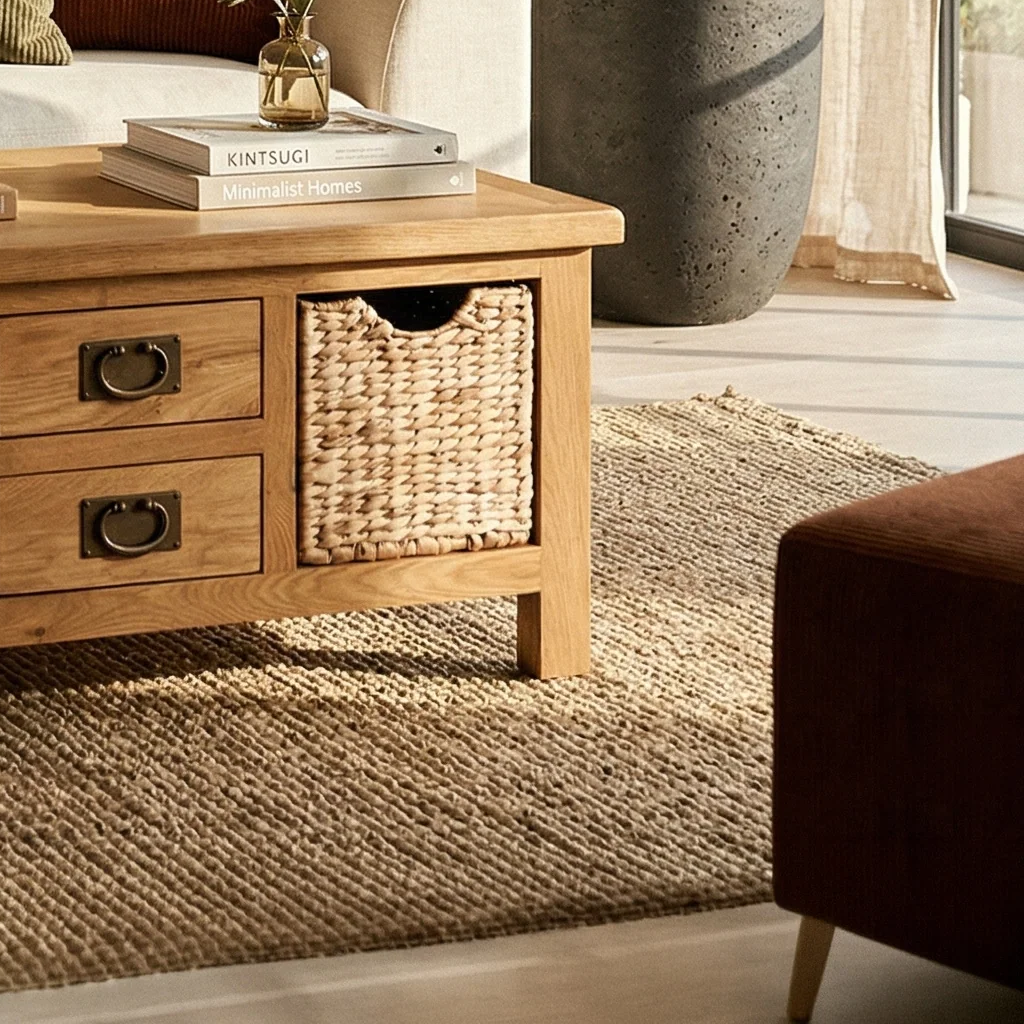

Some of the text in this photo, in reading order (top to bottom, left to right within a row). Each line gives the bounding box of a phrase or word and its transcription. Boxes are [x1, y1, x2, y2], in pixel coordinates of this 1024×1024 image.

[227, 149, 309, 167] KINTSUGI
[222, 179, 363, 201] Minimalist Homes
